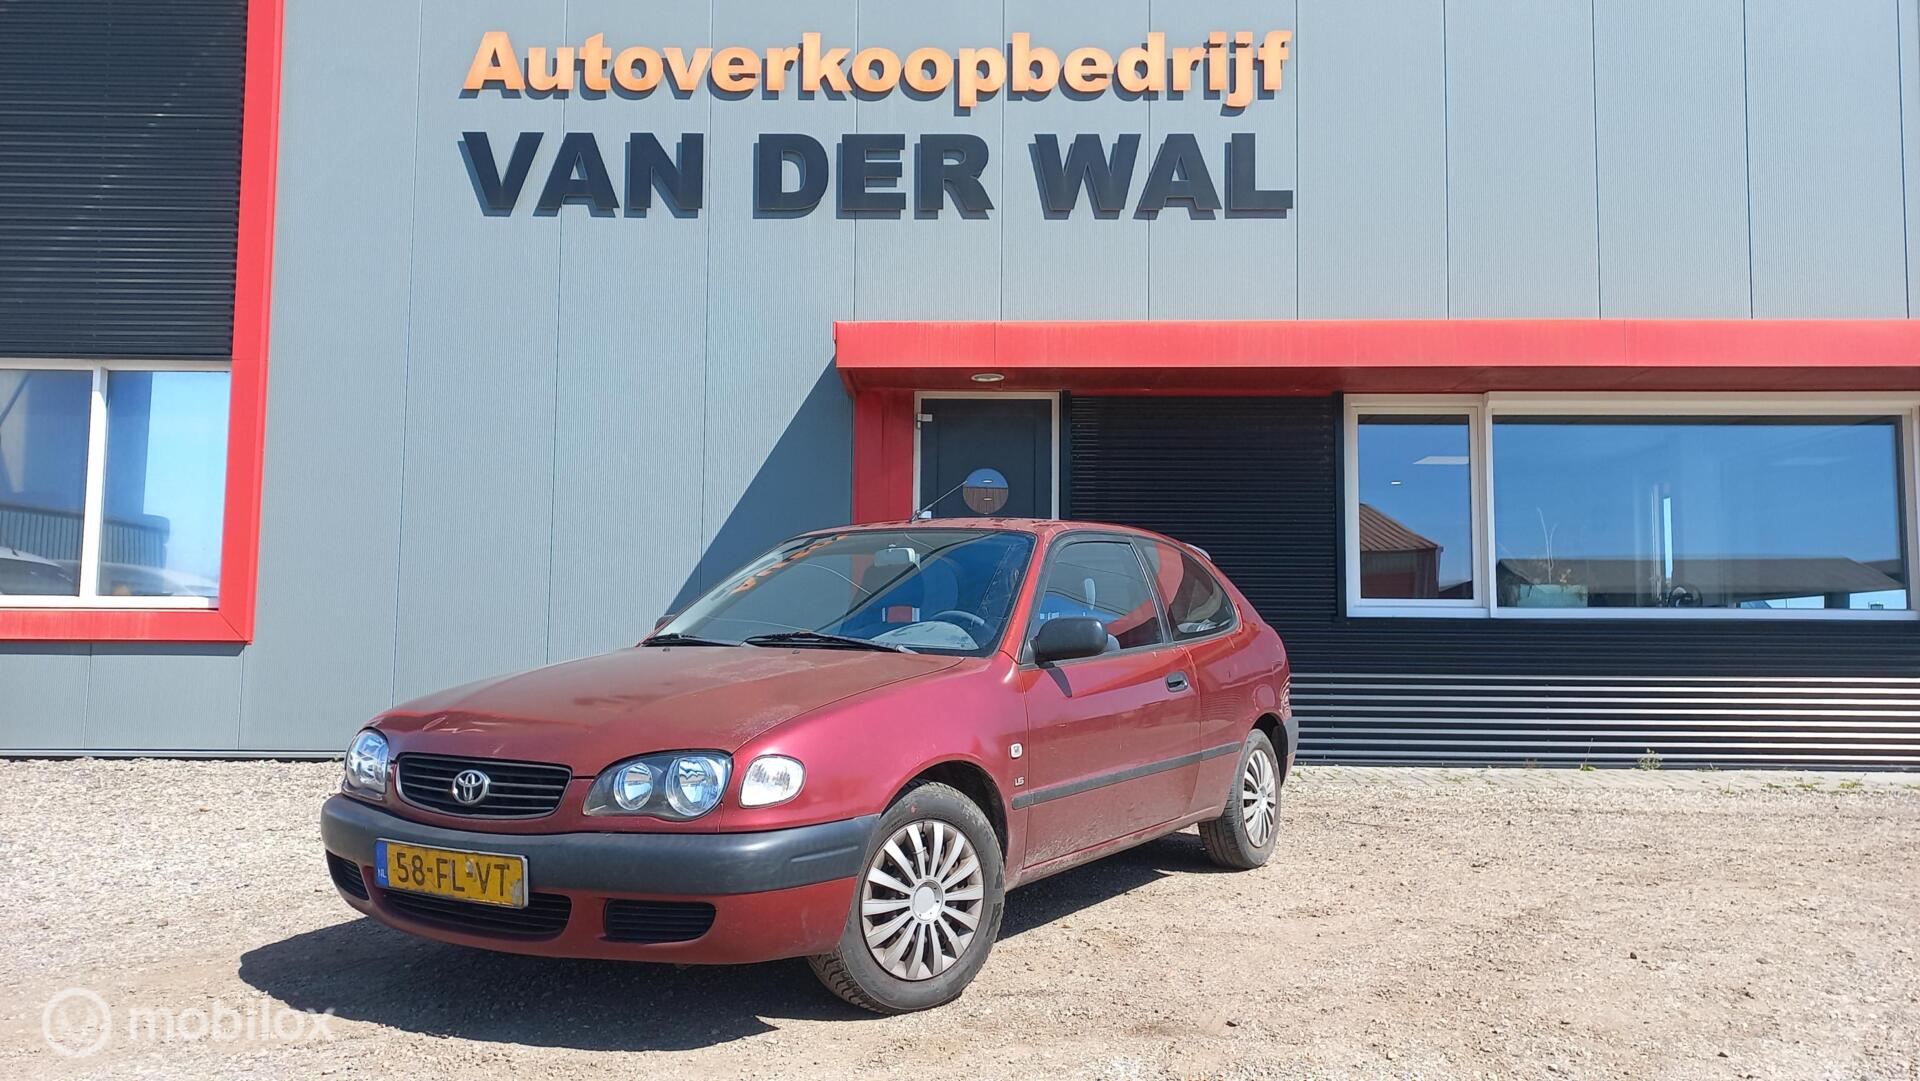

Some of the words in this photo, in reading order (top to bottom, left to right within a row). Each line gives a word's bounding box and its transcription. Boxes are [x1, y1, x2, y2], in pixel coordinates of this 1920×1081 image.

[463, 31, 1292, 107] Autoverkoopbedrijf
[460, 131, 704, 211] VAN
[755, 133, 995, 211] DER
[1032, 132, 1293, 211] WAL
[377, 868, 387, 879] NL
[396, 852, 510, 897] 58-FL-VT
